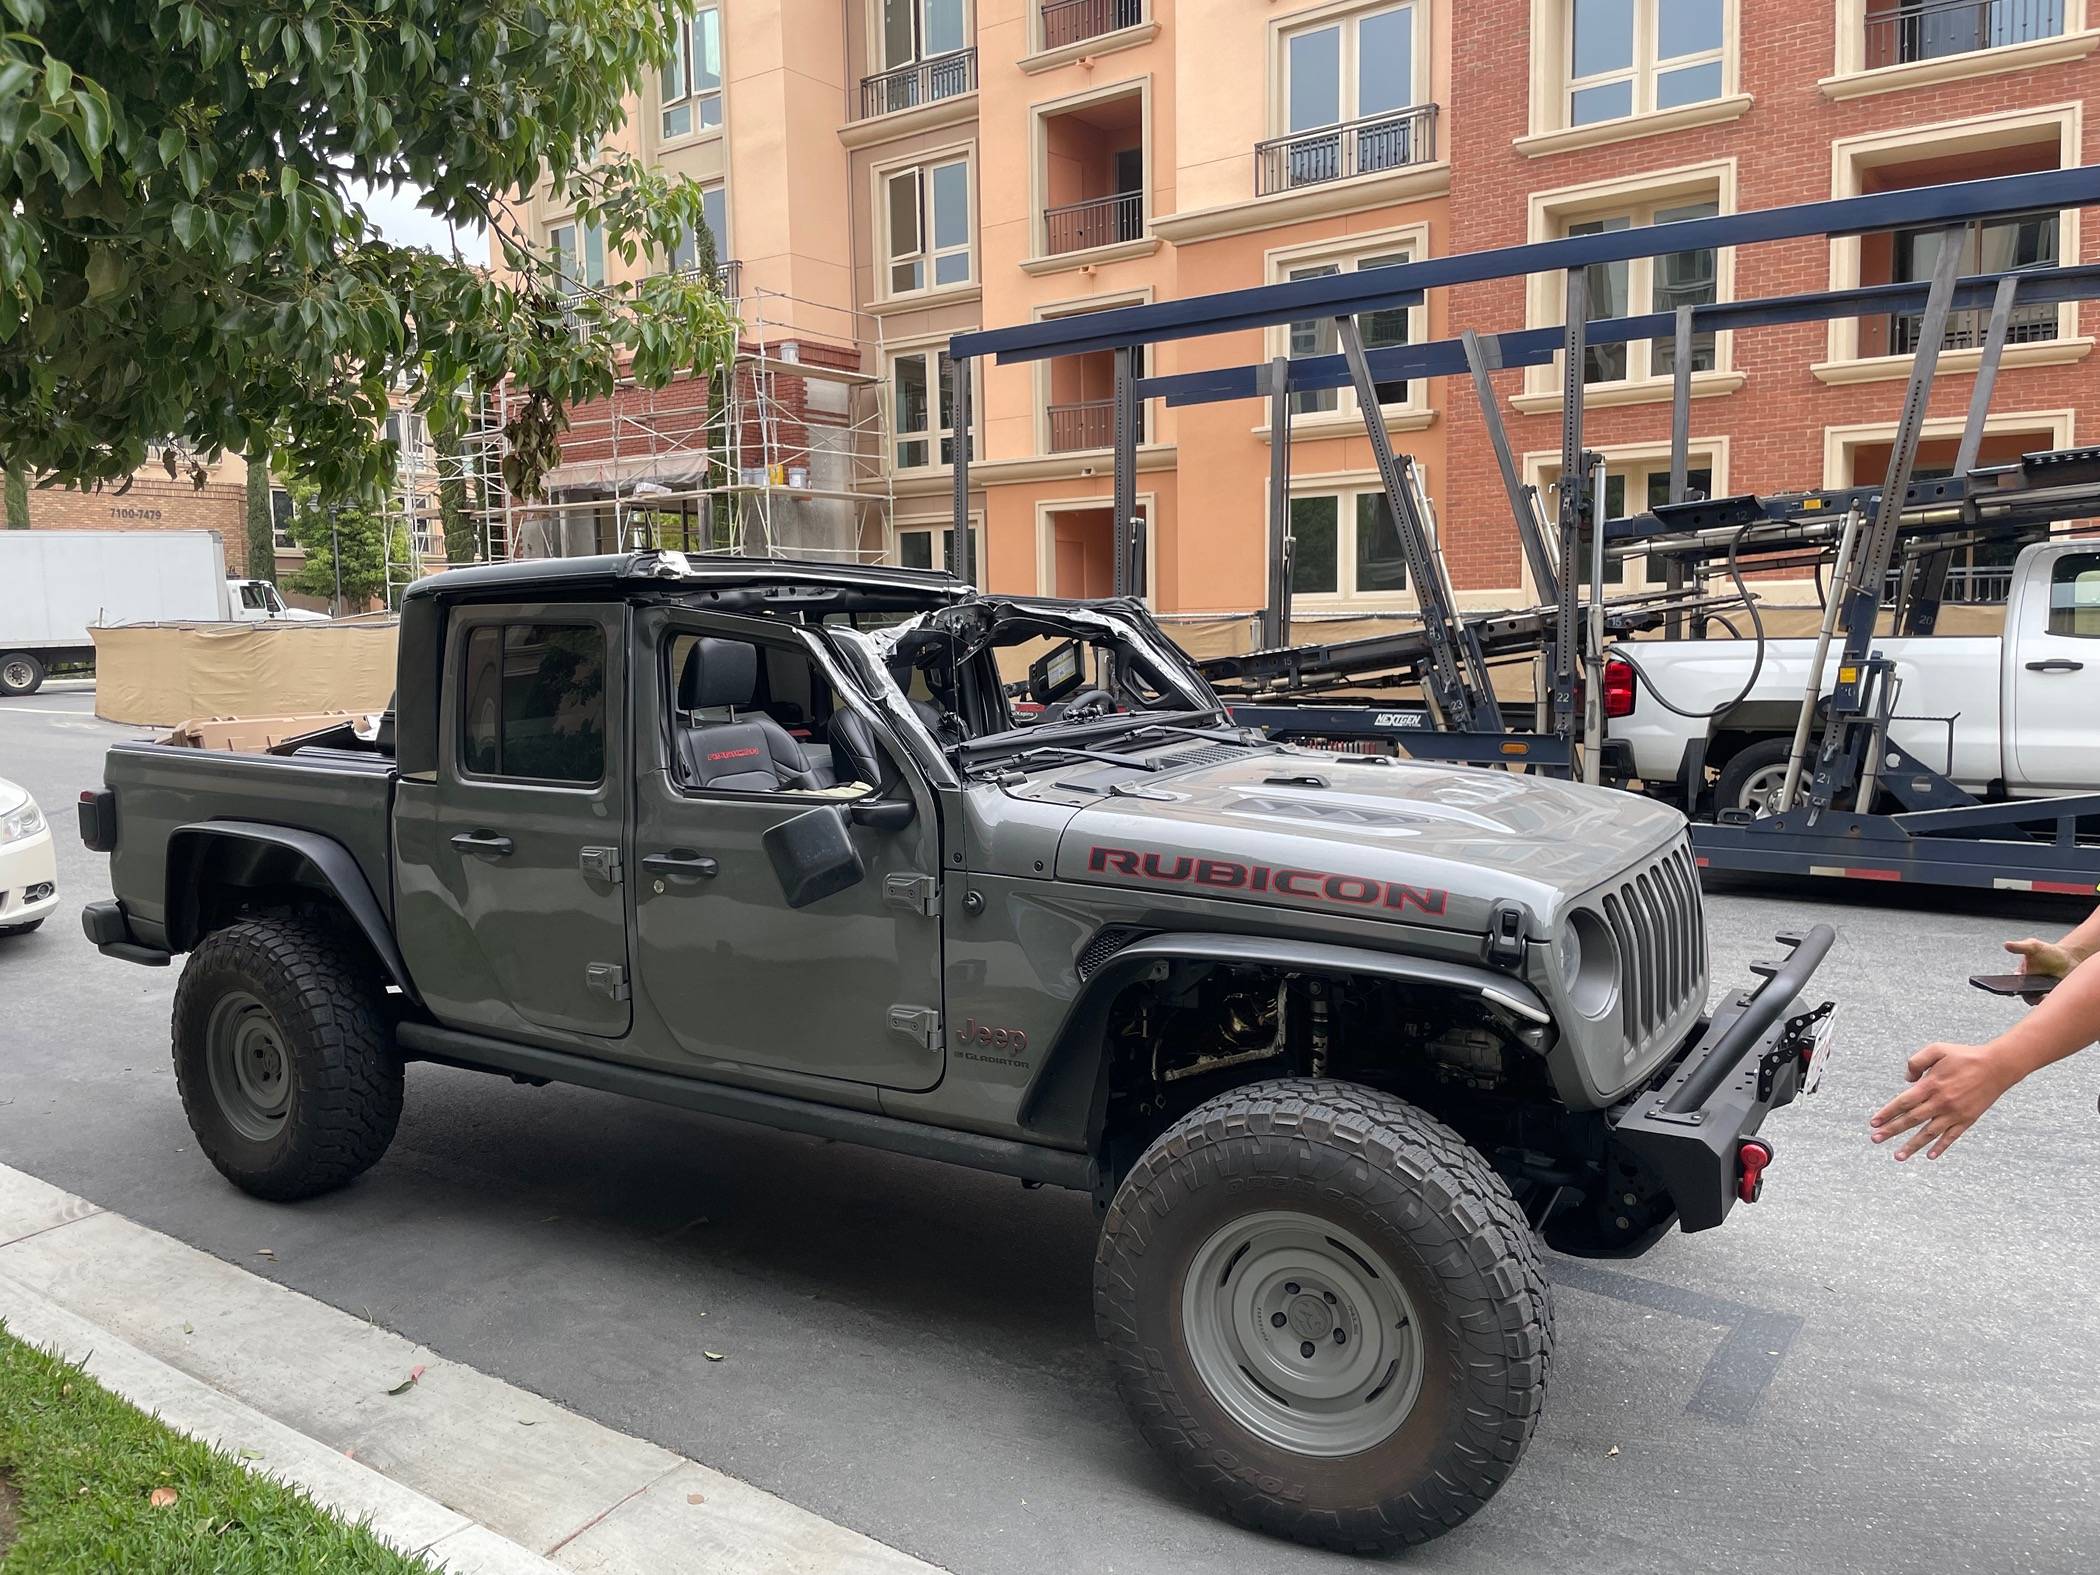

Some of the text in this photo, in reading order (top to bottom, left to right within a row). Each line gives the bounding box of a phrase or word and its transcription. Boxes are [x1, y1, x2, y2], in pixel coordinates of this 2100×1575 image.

[110, 508, 162, 520] 7100-7479
[1918, 614, 1934, 625] 20
[1556, 692, 1570, 703] 22
[1450, 699, 1464, 711] 23
[1374, 713, 1422, 727] NEXTGEN
[1816, 772, 1831, 785] 21
[1088, 846, 1449, 917] RUBICON
[956, 1017, 1028, 1058] Jeep
[965, 1052, 1031, 1069] GLADIATOR
[1211, 1449, 1305, 1504] TOYO
